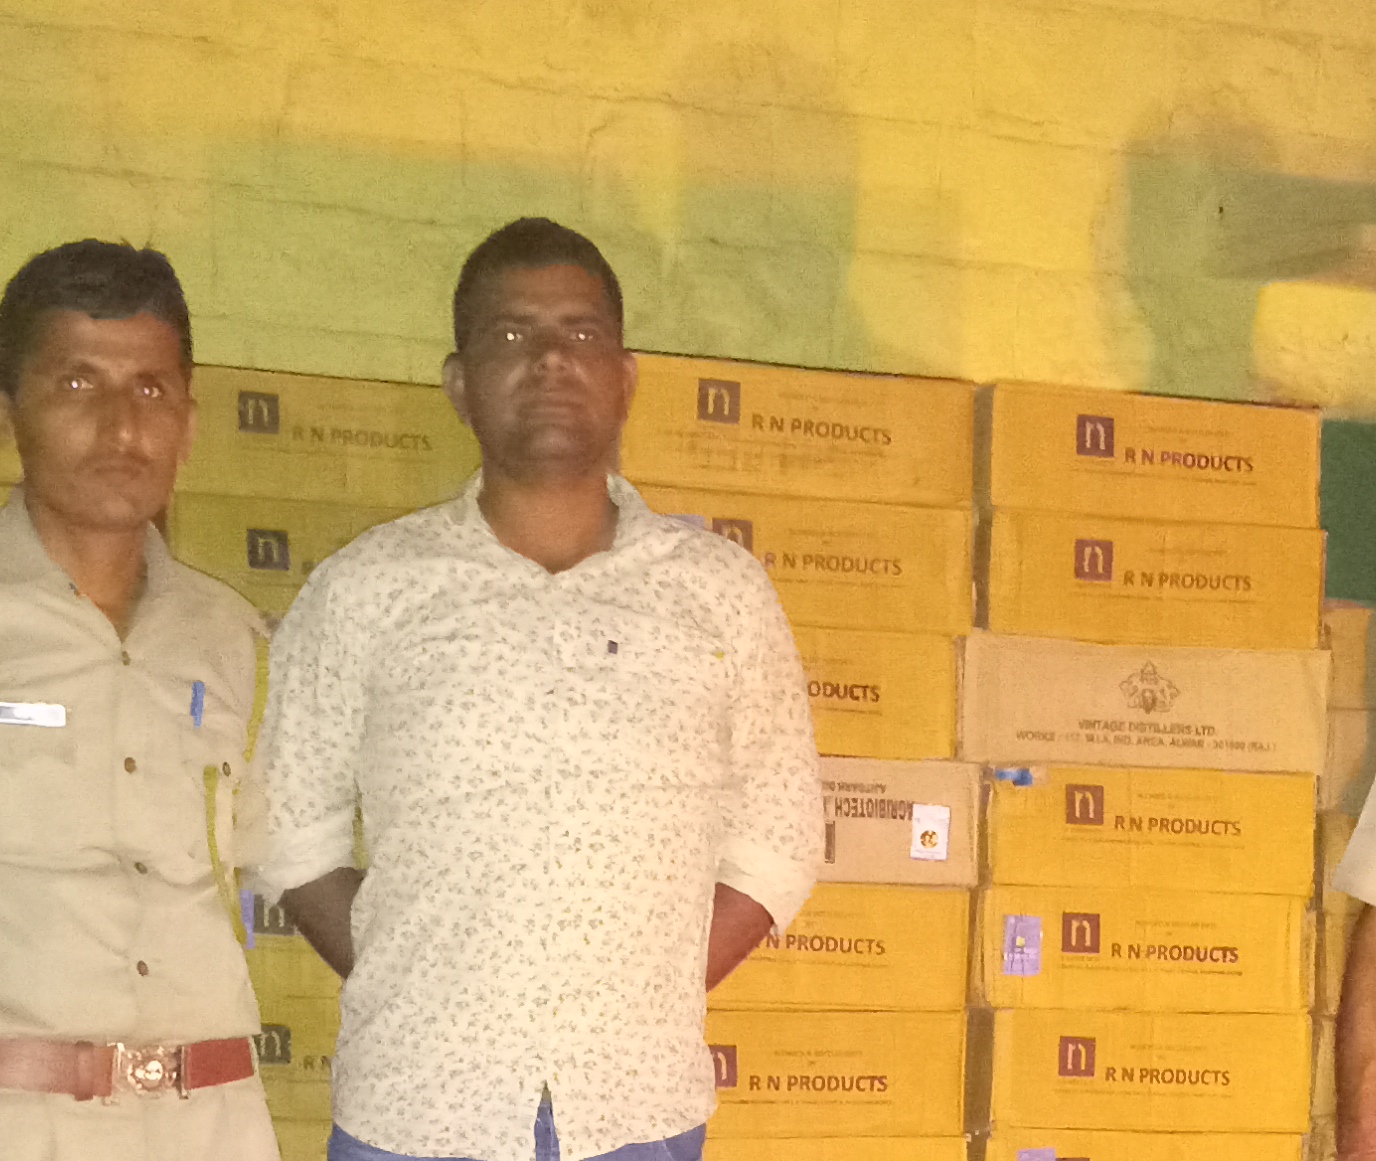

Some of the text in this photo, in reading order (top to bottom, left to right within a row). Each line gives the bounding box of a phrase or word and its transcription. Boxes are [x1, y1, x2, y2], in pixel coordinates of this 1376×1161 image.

[752, 413, 891, 446] R N PRODUCTS
[1125, 447, 1253, 472] R N PRODUCTS
[764, 552, 902, 576] R N PRODUCTS
[1123, 570, 1251, 591] R N PRODUCTS
[807, 681, 880, 702] ODUCTS
[835, 797, 913, 820] AGRIBIOTECH
[1114, 816, 1241, 836] R N PRODUCTS
[766, 934, 885, 955] N PRODUCTS
[1111, 943, 1239, 963] R N PRODUCTS
[750, 1075, 888, 1092] R N PRODUCTS
[1105, 1067, 1230, 1086] R N PRODUCTS
